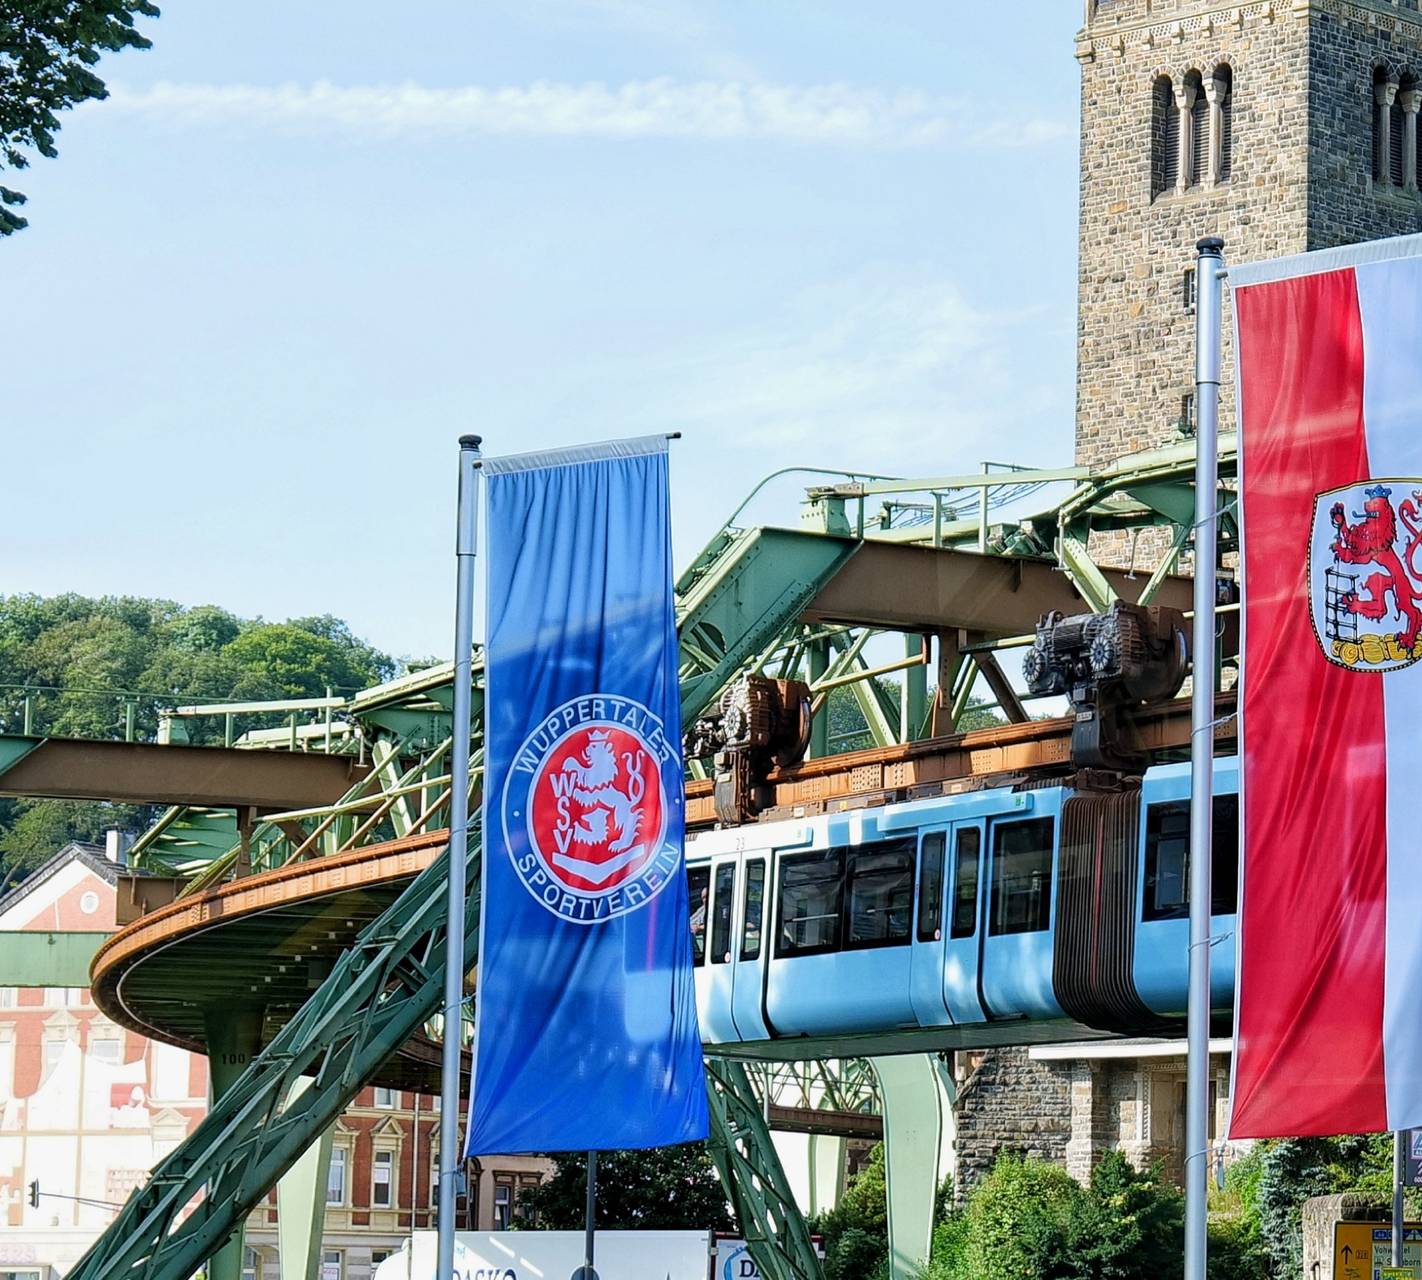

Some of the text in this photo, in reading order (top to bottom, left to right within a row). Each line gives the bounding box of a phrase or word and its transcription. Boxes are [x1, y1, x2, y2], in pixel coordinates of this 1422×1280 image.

[516, 699, 670, 775] WUPPERTALER
[518, 842, 680, 919] SPORTVEREIN
[221, 1053, 245, 1065] 100
[1386, 1257, 1421, 1266] Sborn
